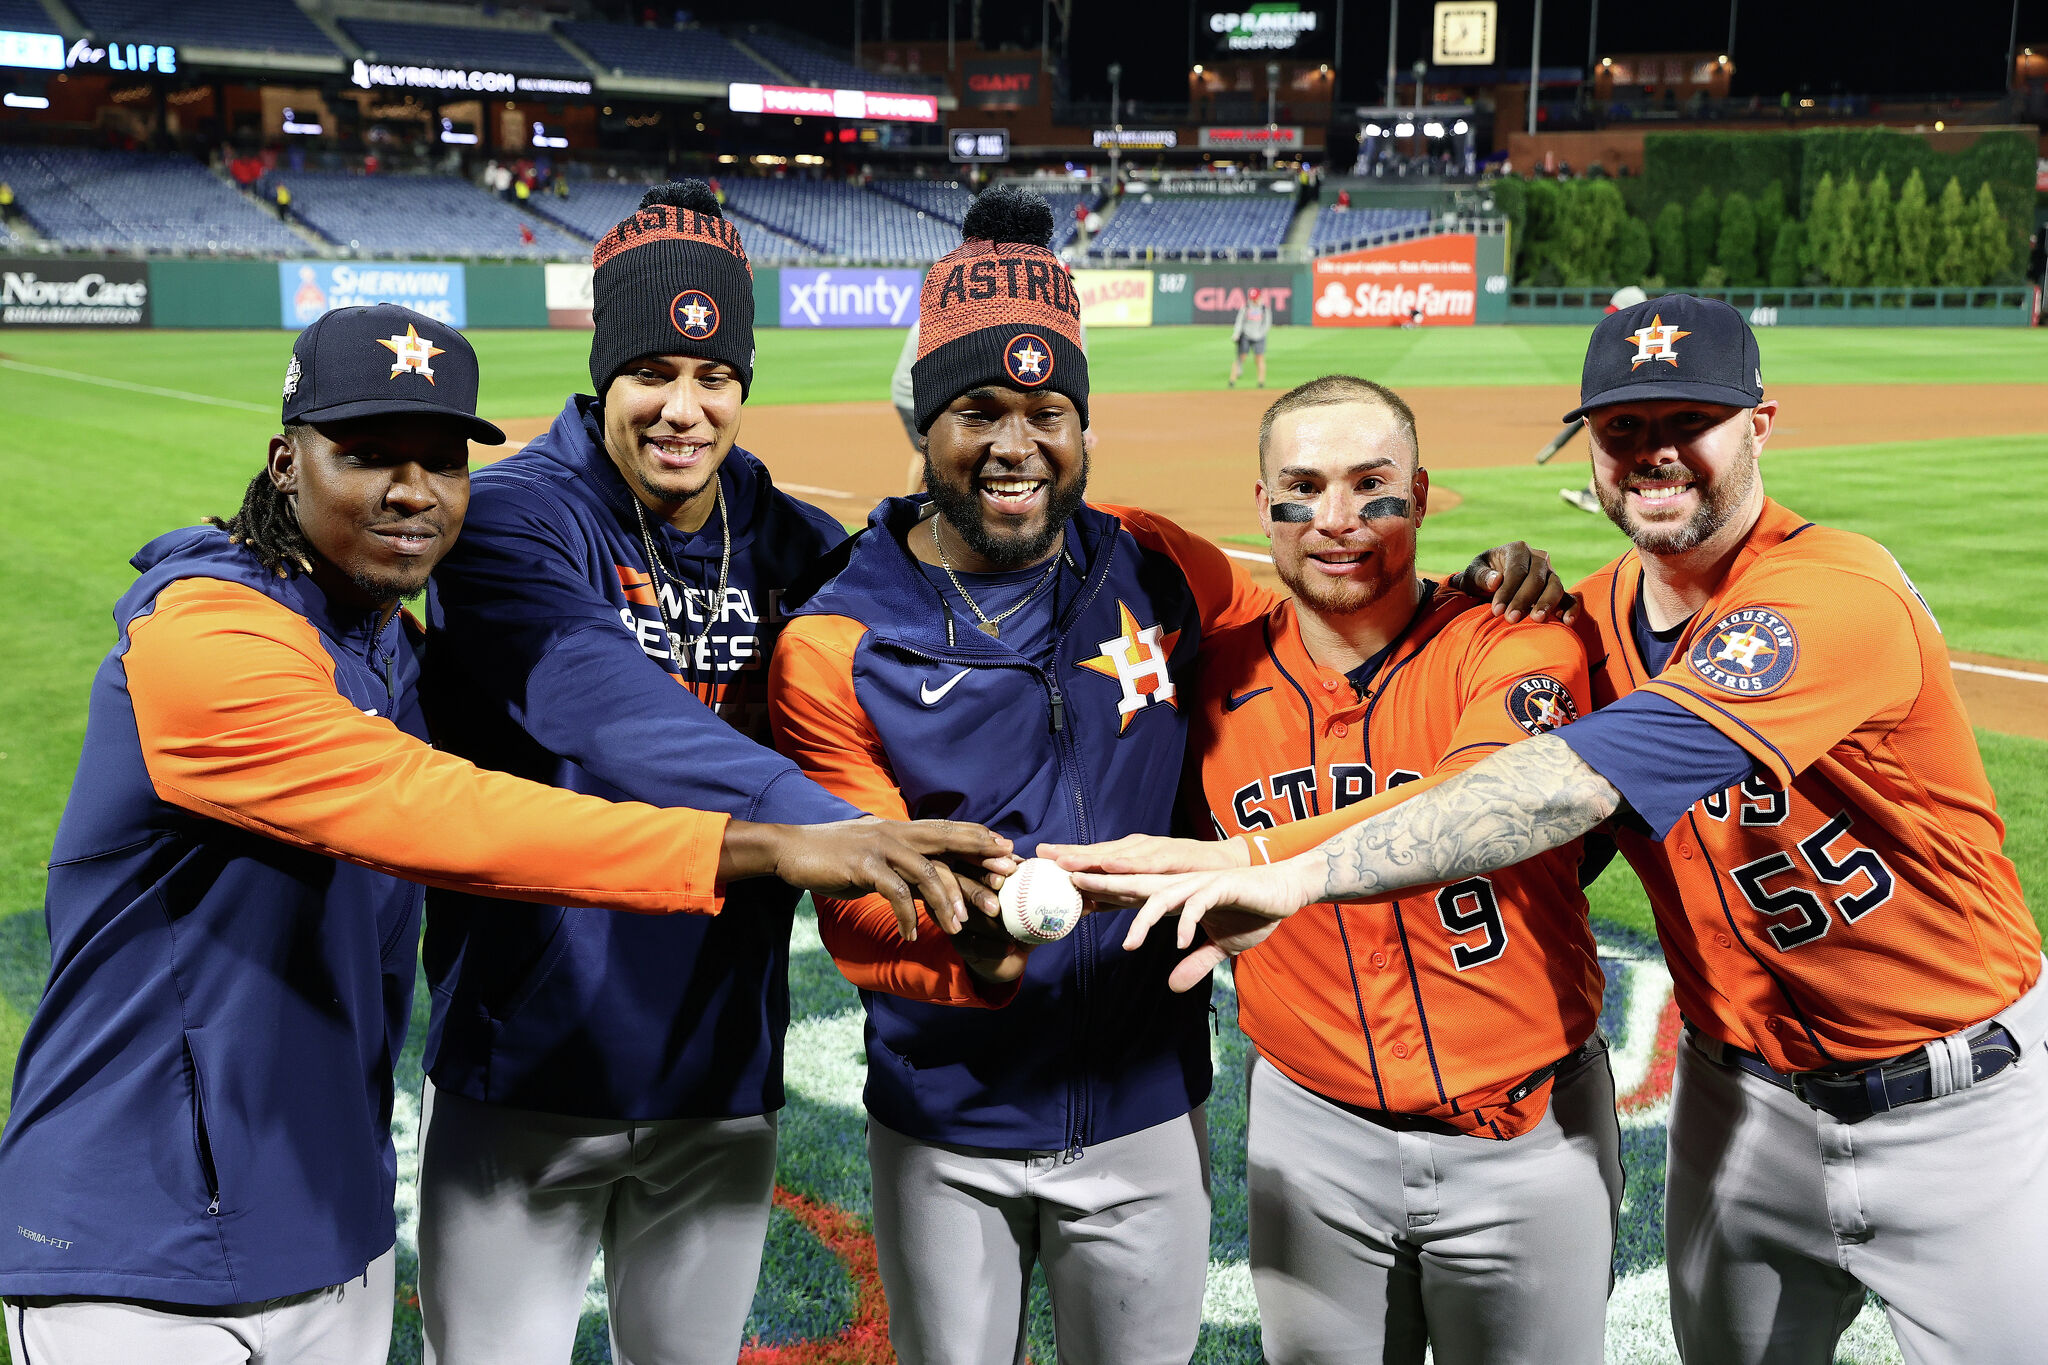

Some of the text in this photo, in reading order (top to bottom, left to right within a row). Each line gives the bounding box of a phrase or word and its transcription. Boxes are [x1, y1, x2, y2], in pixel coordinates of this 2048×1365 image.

[108, 42, 176, 73] LIFE
[763, 89, 834, 113] TOYOTA
[865, 95, 933, 118] TOYOTA
[2, 272, 147, 306] NovaCare
[329, 265, 450, 296] SHERWIN
[1158, 273, 1187, 293] 387
[789, 272, 914, 325] xfinity
[1353, 282, 1475, 317] State Farm
[1750, 306, 1778, 326] 401
[1717, 610, 1793, 647] HOUSTON
[1694, 658, 1763, 690] ASTROS
[1520, 678, 1579, 720] HOUSTON
[1729, 808, 1896, 952] 55
[1435, 875, 1509, 972] 9
[17, 1225, 73, 1250] THERMA-FIT
